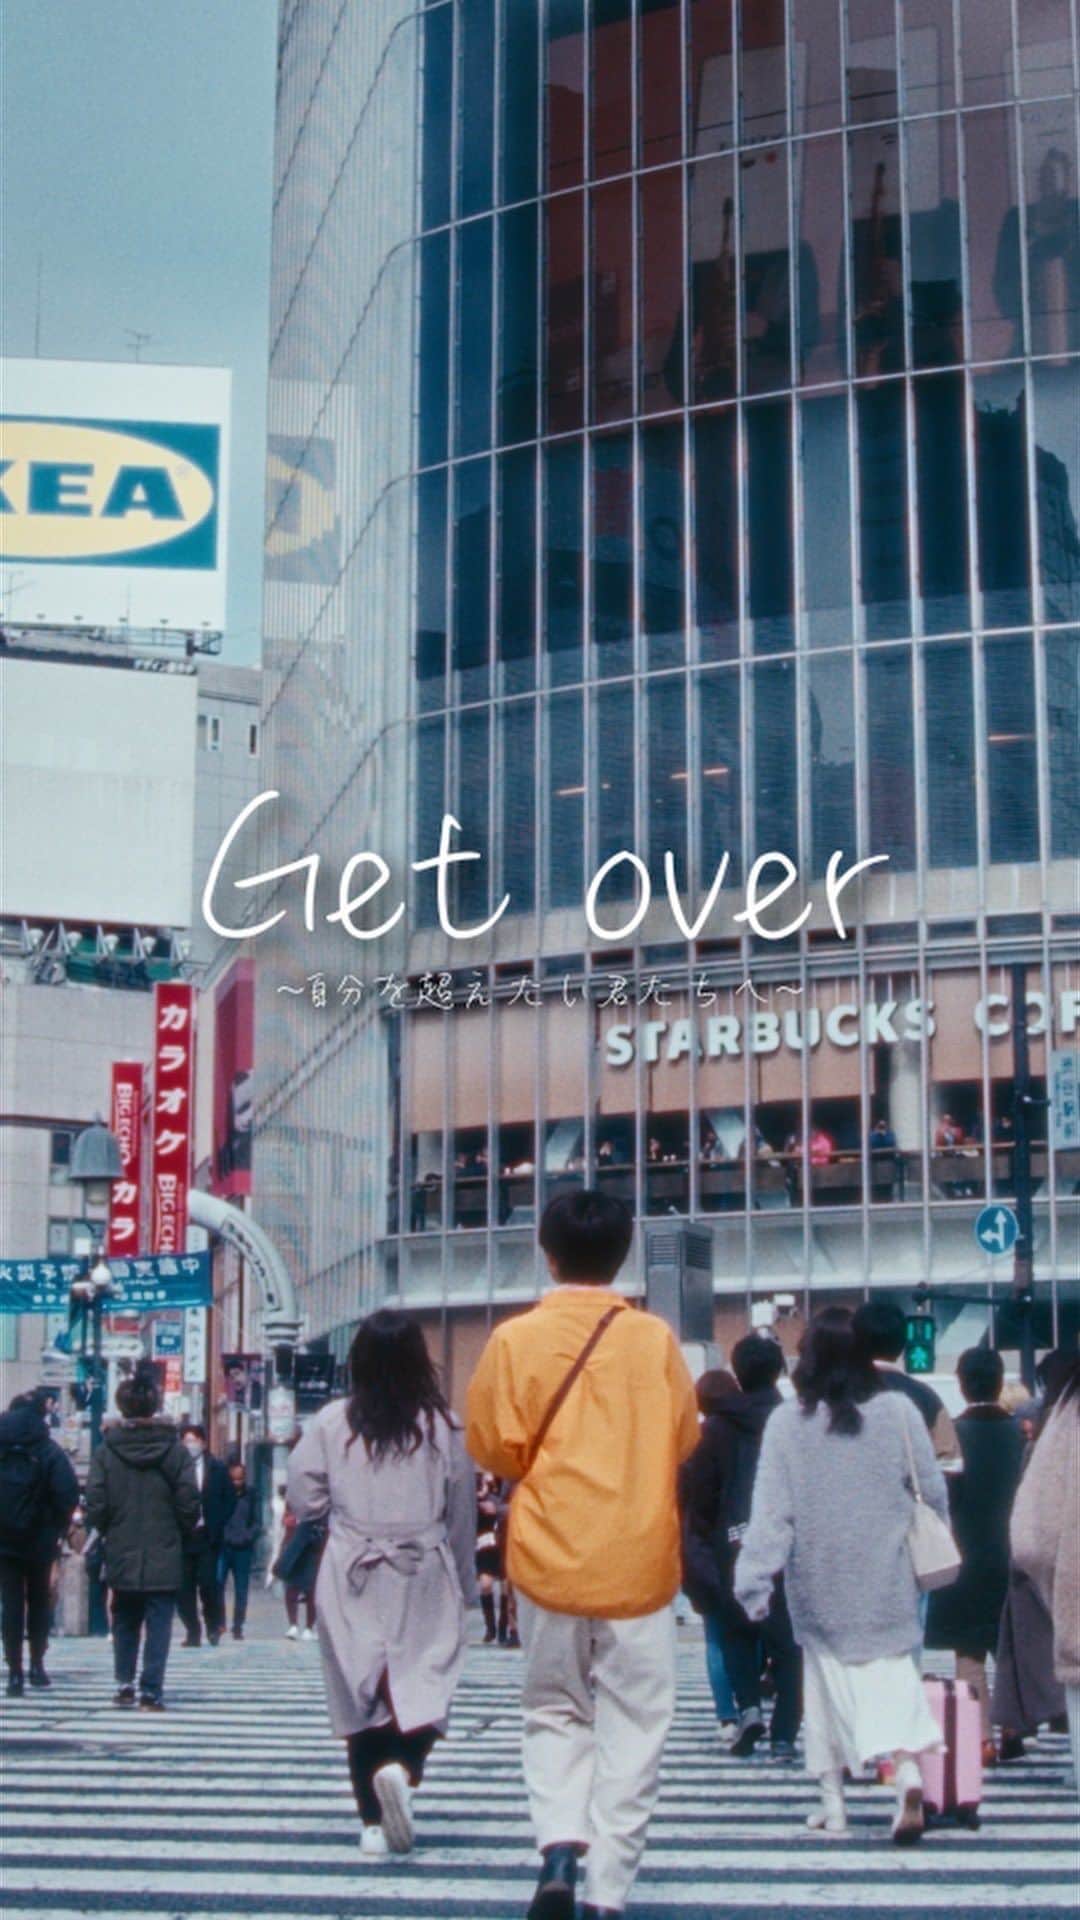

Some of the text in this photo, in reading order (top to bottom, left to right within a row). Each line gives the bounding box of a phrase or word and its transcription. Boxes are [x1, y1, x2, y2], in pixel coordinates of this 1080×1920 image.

[604, 998, 936, 1067] STARBUCKS
[155, 1003, 188, 1155] カラオケ
[157, 1173, 177, 1254] BIG ECH
